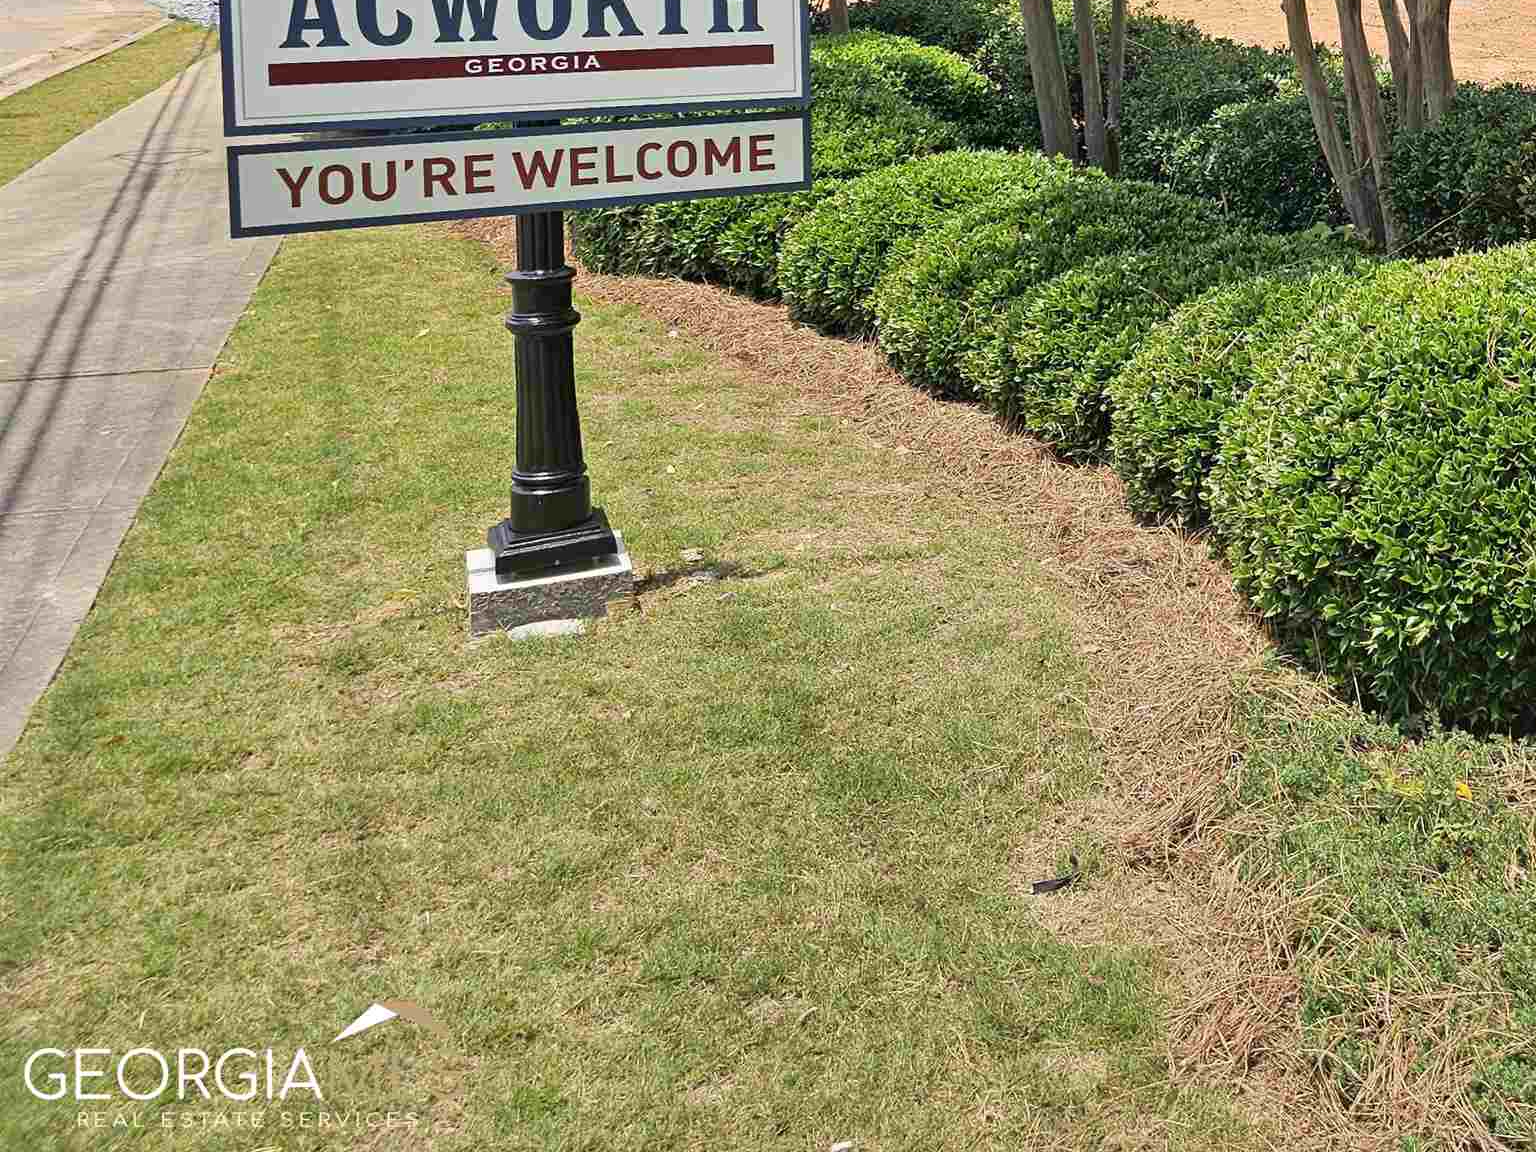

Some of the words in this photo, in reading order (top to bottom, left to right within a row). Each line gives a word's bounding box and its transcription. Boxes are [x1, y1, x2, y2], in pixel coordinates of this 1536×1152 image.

[464, 54, 602, 74] GEORGIA
[276, 152, 496, 209] YOU'RE
[512, 133, 778, 191] WELCOME
